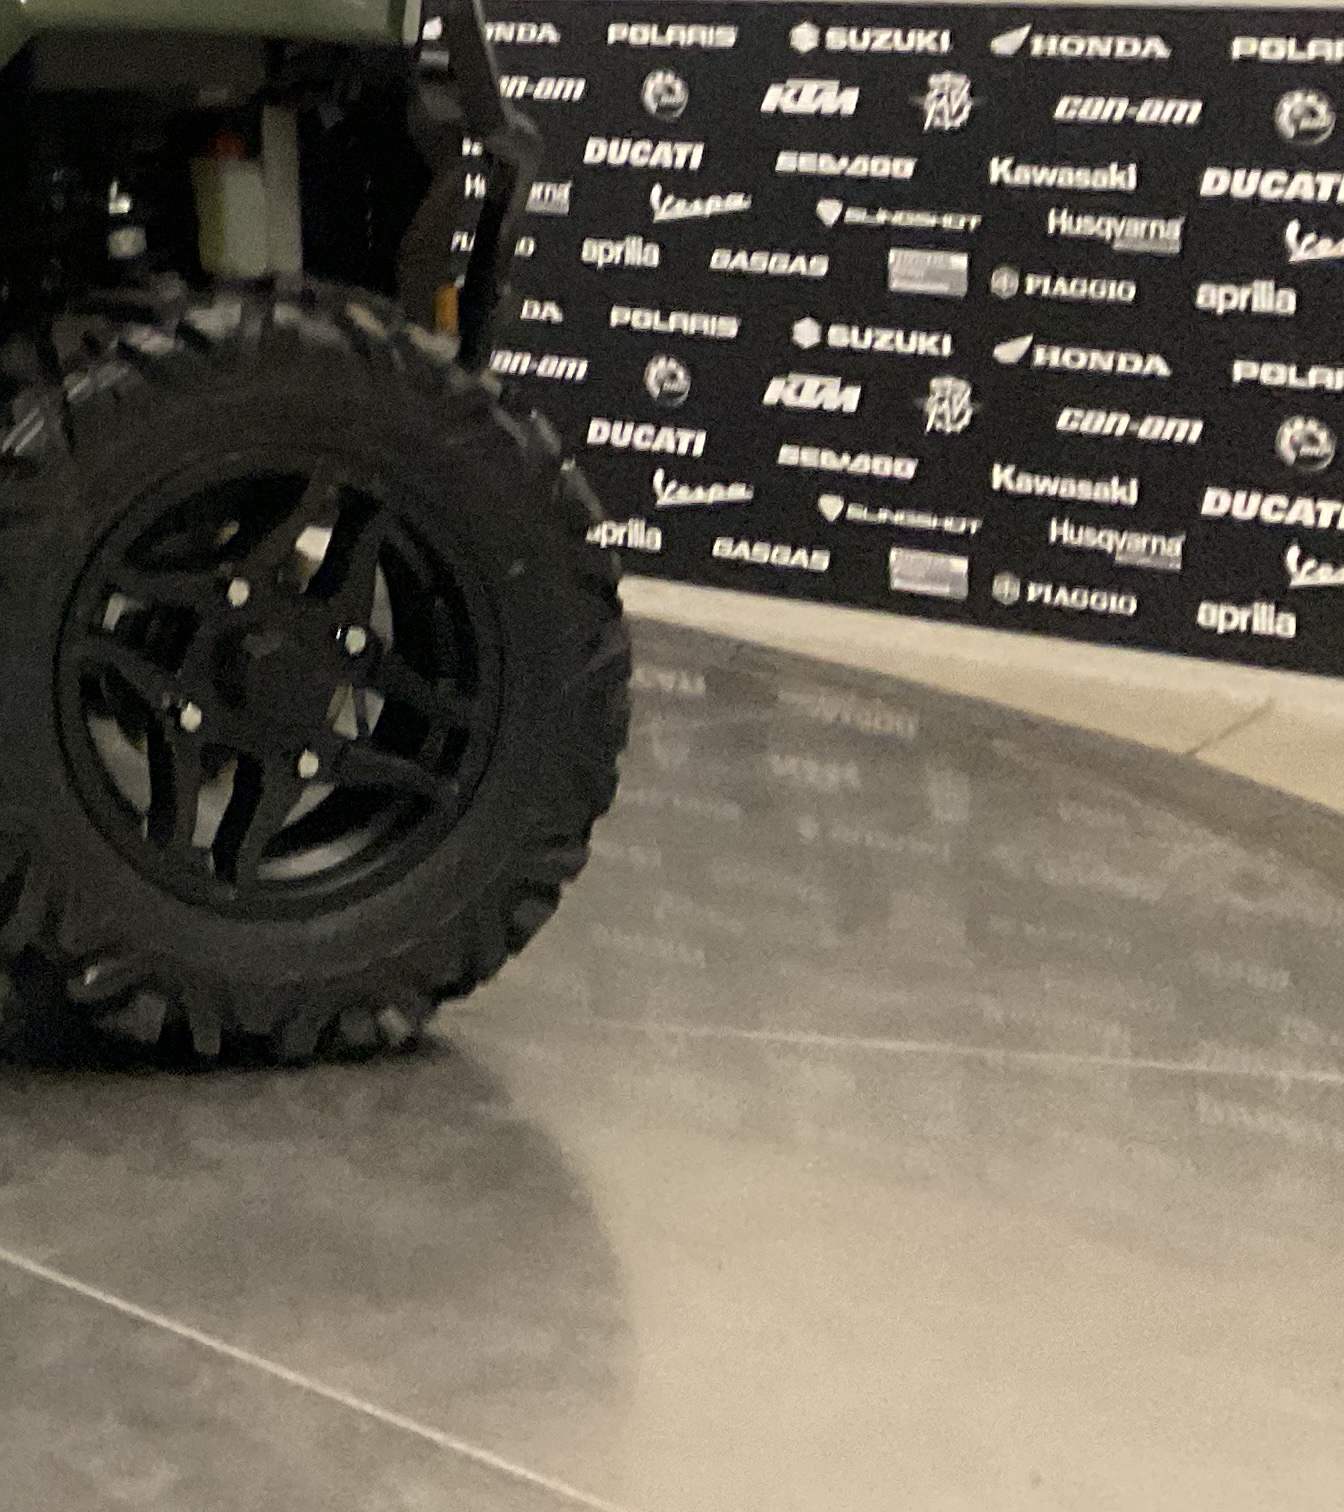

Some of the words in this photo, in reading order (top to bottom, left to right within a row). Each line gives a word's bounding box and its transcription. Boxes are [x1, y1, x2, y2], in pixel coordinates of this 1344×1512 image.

[608, 24, 737, 47] POLARIS
[826, 27, 950, 52] SUZUKI
[1030, 32, 1173, 60] HONDA
[761, 79, 859, 115] KTM
[584, 138, 704, 169] DUCATI
[990, 157, 1136, 190] Kawasaki
[650, 184, 751, 222] Vespa
[582, 237, 659, 268] aprilia
[710, 249, 828, 276] GASGAS
[1025, 274, 1136, 301] PIAGGIO
[1196, 280, 1296, 314] aprilia
[611, 306, 739, 338] POLARIS
[828, 325, 951, 356] SUZUKI
[491, 351, 587, 380] an-am
[1032, 343, 1173, 378] HONDA
[763, 373, 861, 412] KTM
[587, 419, 706, 456] DUCATI
[653, 468, 753, 506] Vespa
[992, 463, 1138, 505] Kawasaki
[713, 538, 830, 571] GASGAS
[1027, 582, 1137, 615] PIAGGIO
[1197, 602, 1296, 638] aprilia
